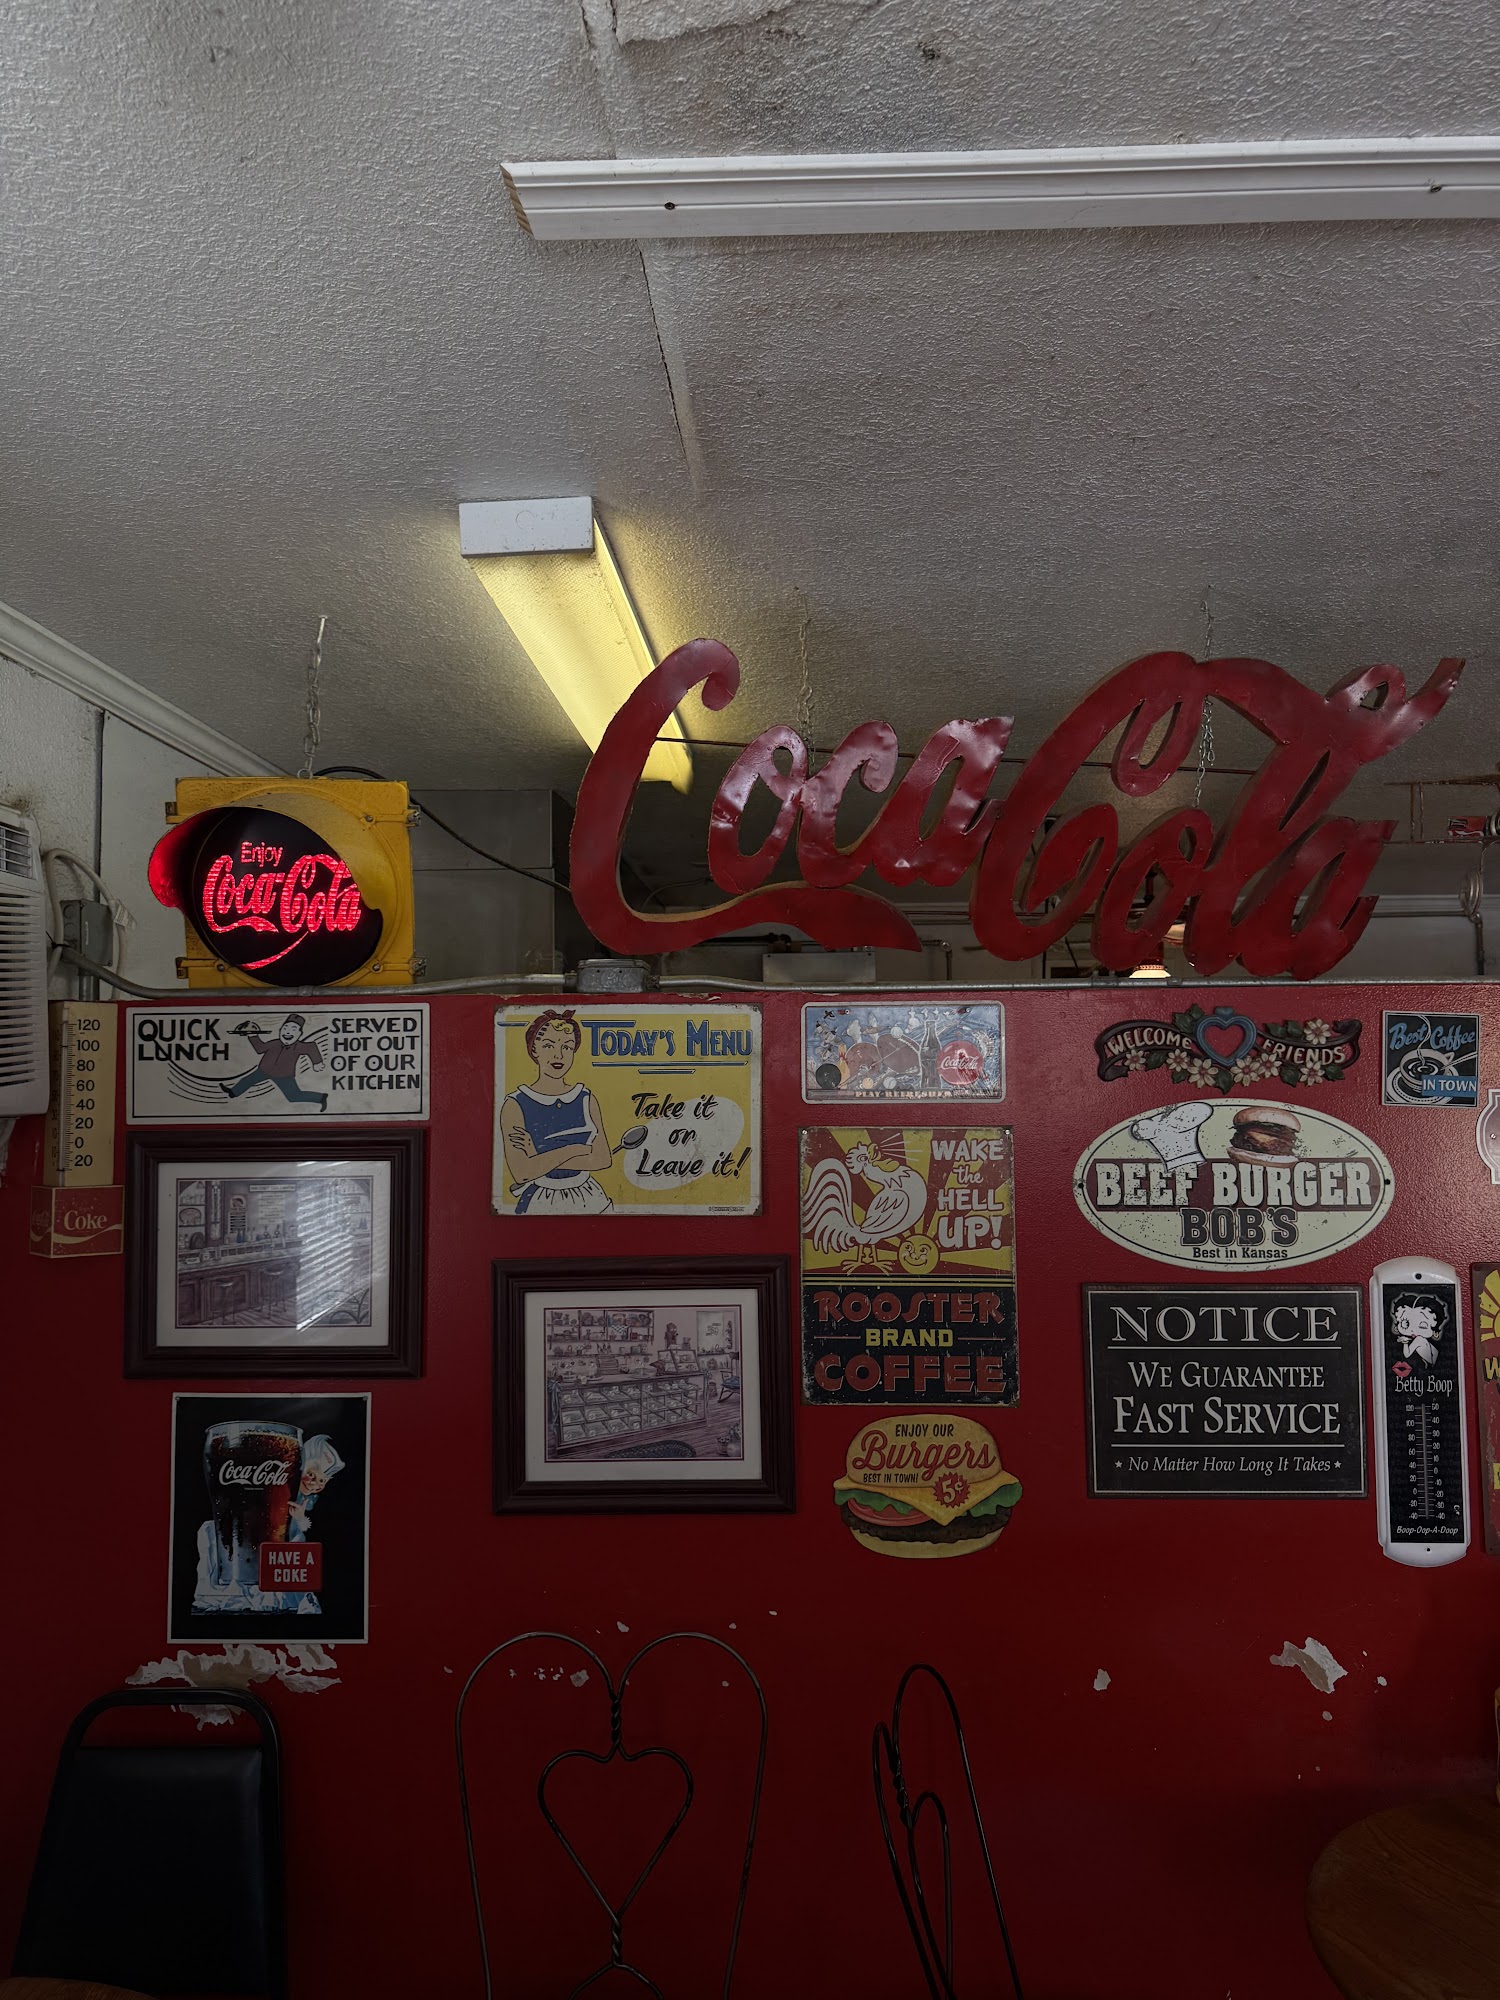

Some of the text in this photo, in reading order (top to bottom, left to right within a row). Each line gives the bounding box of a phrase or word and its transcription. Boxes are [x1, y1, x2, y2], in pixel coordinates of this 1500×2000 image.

[240, 841, 283, 868] Enjoy
[77, 1019, 101, 1031] 120
[138, 1018, 220, 1041] QUICK
[330, 1017, 417, 1034] SERVED
[77, 1040, 100, 1052] 100
[334, 1035, 420, 1052] HOT OUT
[1102, 1027, 1192, 1058] WELCOME
[1389, 1022, 1476, 1052] Best Coffee
[138, 1043, 229, 1061] LUNCH
[1262, 1038, 1346, 1066] FRIENDS
[76, 1060, 95, 1071] 80
[330, 1054, 416, 1071] OF OUR
[76, 1079, 95, 1091] 60
[332, 1074, 420, 1090] KITCHEN
[1423, 1079, 1477, 1092] IN TOWN
[75, 1099, 95, 1110] 40
[631, 1092, 719, 1120] Take it
[75, 1117, 93, 1129] 20
[74, 1137, 84, 1149] 0
[668, 1128, 696, 1147] or
[931, 1139, 1004, 1161] WAKE
[74, 1155, 93, 1167] 20
[635, 1147, 753, 1178] Leave it!
[952, 1164, 984, 1184] the
[1095, 1160, 1373, 1207] BEEF BURGER
[938, 1188, 1004, 1211] HELL
[64, 1210, 107, 1231] Coke
[1180, 1207, 1299, 1247] BOB'S
[938, 1215, 1003, 1250] UP!
[1192, 1246, 1288, 1259] Best in Kansas
[813, 1290, 1006, 1324] ROOSTER
[1110, 1306, 1339, 1342] NOTICE
[865, 1328, 954, 1347] BRAND
[814, 1353, 1007, 1393] COFFEE
[1394, 1375, 1453, 1397] Betty Boop
[895, 1423, 954, 1437] ENJOY OUR
[852, 1430, 997, 1481] Burgers
[219, 1459, 293, 1485] Coca-Cola
[1128, 1456, 1332, 1477] No Matter How Long It Takes
[863, 1473, 919, 1483] BEST IN TOWN!
[940, 1479, 964, 1504] 5¢
[1396, 1525, 1459, 1536] Boop-Oop-A-Doop
[269, 1551, 314, 1565] HAVE A
[273, 1568, 307, 1583] COKE
